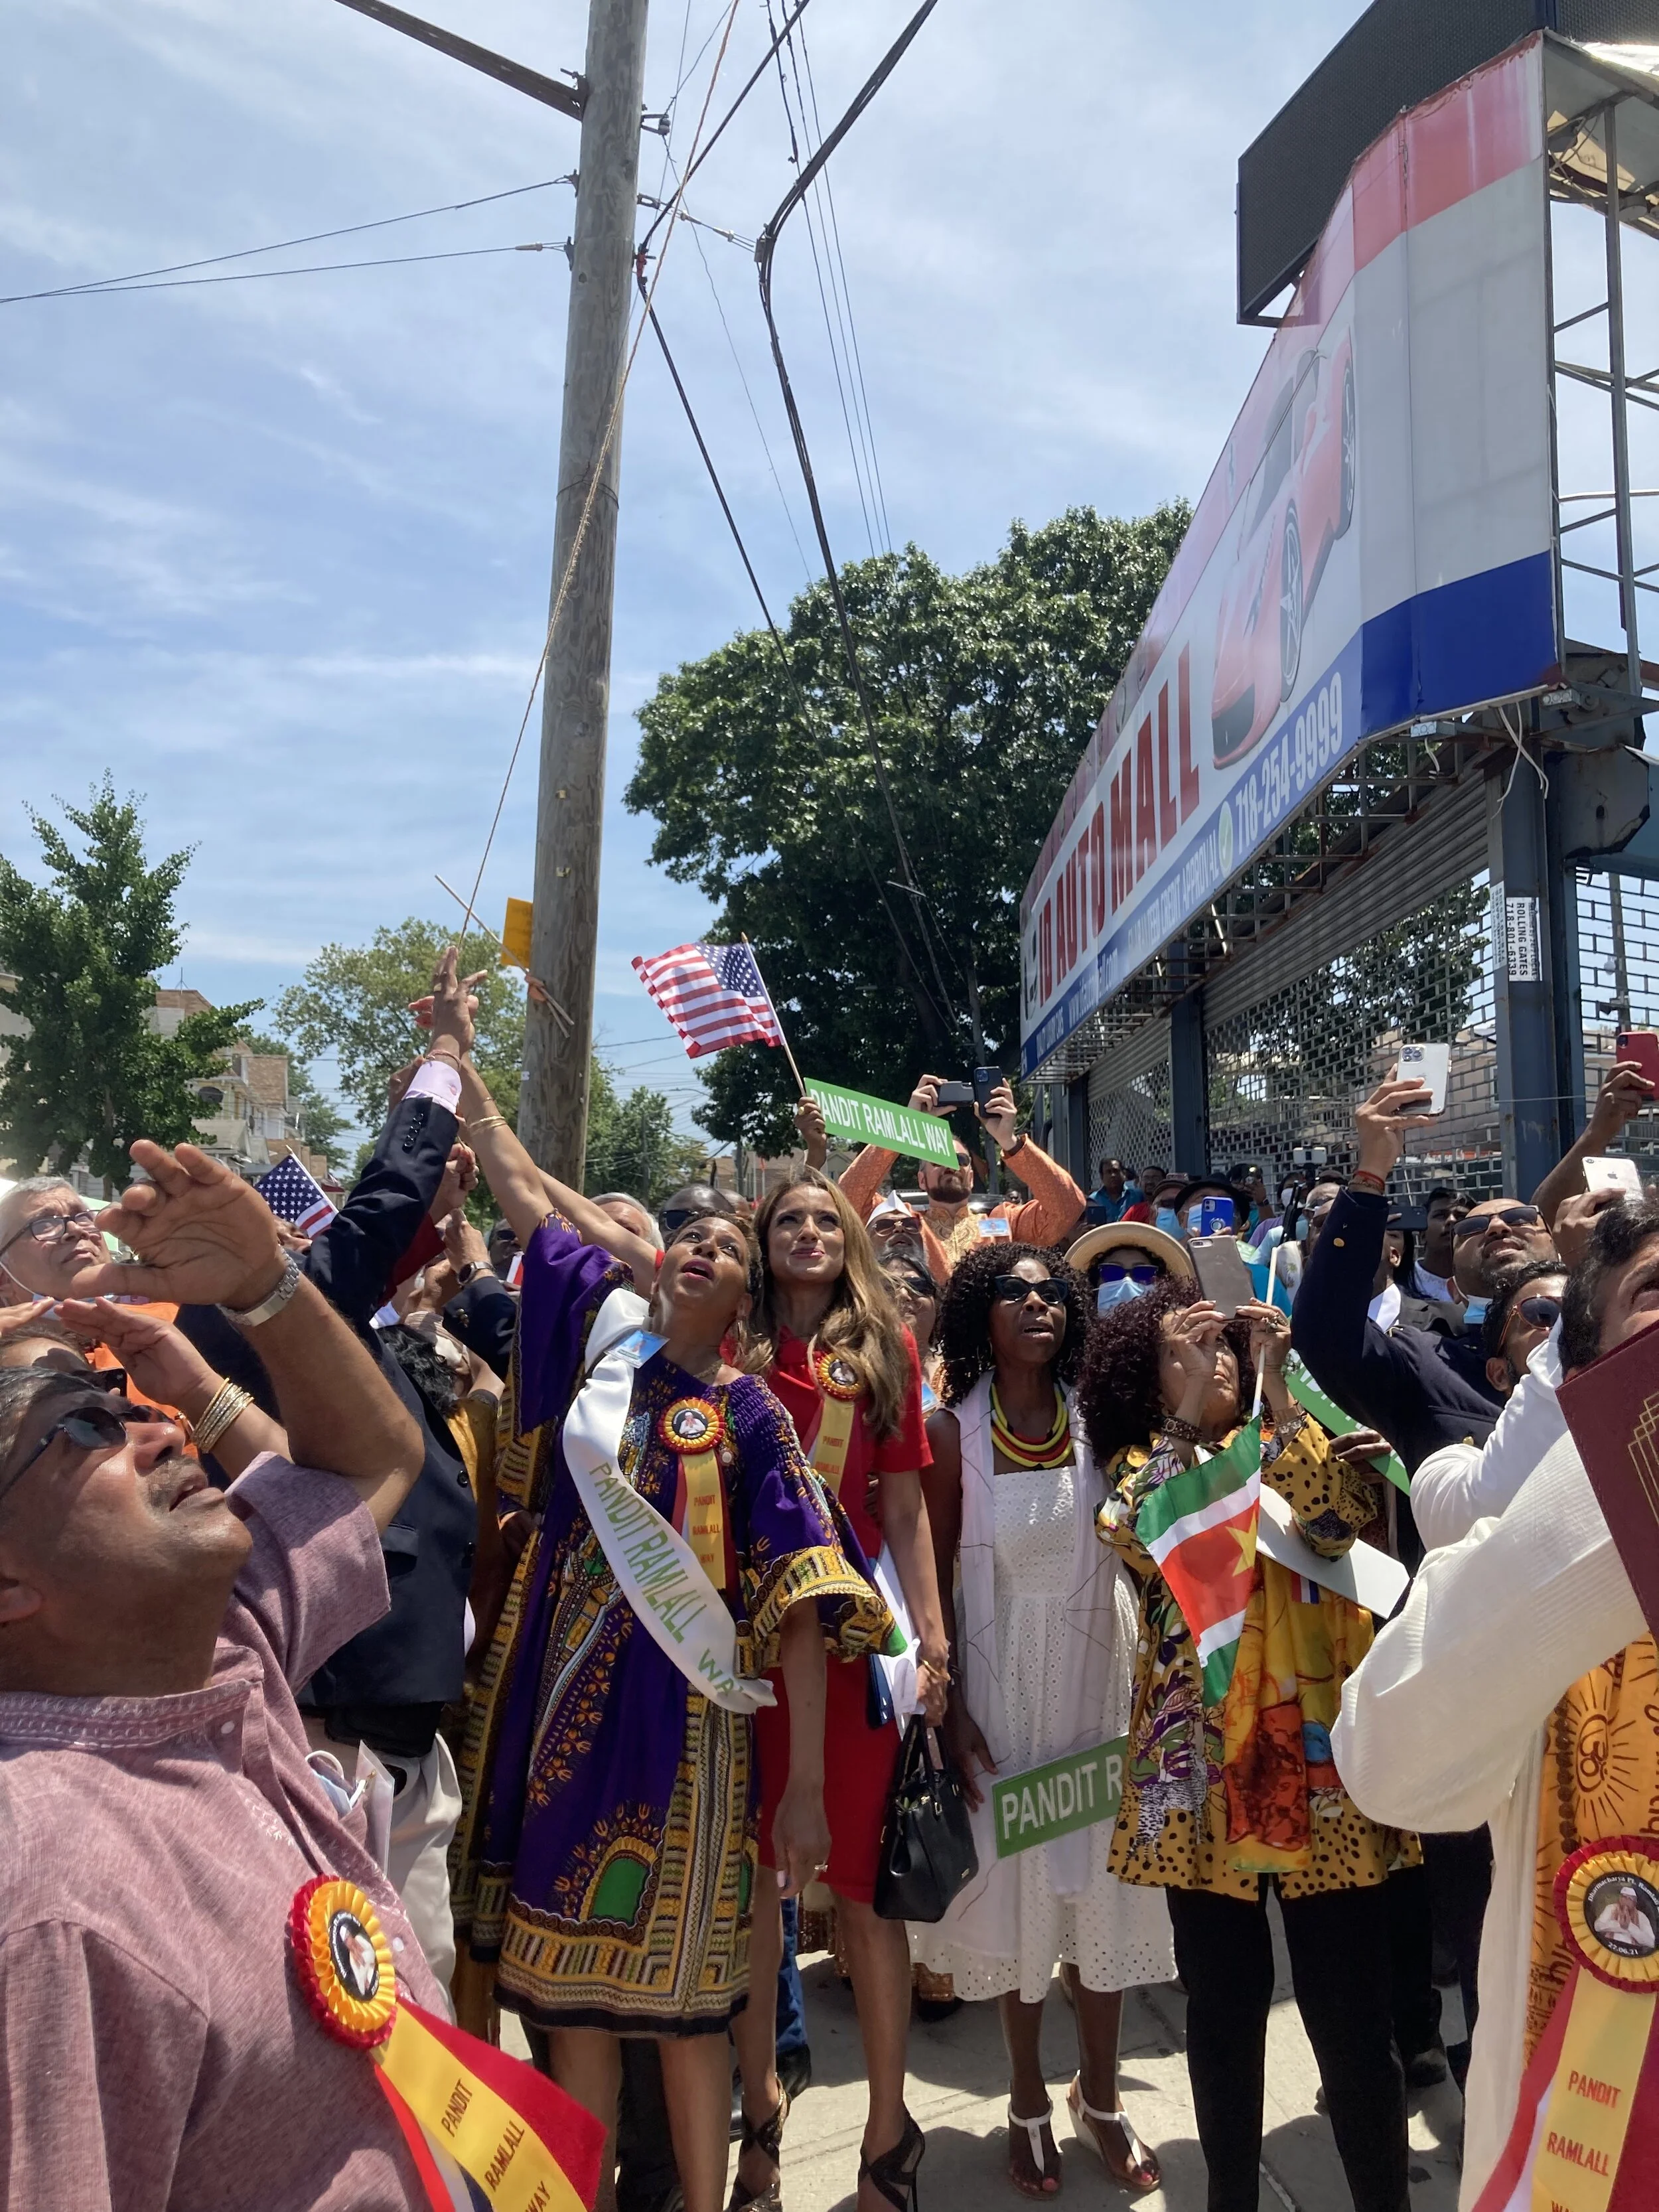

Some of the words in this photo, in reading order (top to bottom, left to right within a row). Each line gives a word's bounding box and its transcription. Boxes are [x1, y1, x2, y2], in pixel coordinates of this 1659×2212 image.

[1236, 672, 1342, 855] 718-254-9999
[1056, 800, 1104, 988] AUTO
[1110, 640, 1199, 917] MALL
[1182, 829, 1220, 913] APPROVAL
[1506, 903, 1517, 976] 718-801-6339
[1516, 903, 1526, 942] ROLLING
[1518, 946, 1528, 976] GATES
[810, 1088, 861, 1130] PANDIT
[862, 1102, 926, 1149] RAMLALL
[922, 1122, 950, 1157] WAY
[589, 1462, 660, 1541] PANDIT
[693, 1494, 715, 1507] PANDIT
[623, 1530, 707, 1644] RAMLALL
[698, 1648, 744, 1696] WA
[1002, 1761, 1098, 1840] PANDIT
[1607, 1942, 1639, 1956] 27.06.21
[441, 2077, 472, 2138] PANDIT
[1568, 2070, 1622, 2108] PANDIT
[484, 2119, 526, 2193] RAMLALL
[1547, 2131, 1609, 2177] RAMLALL
